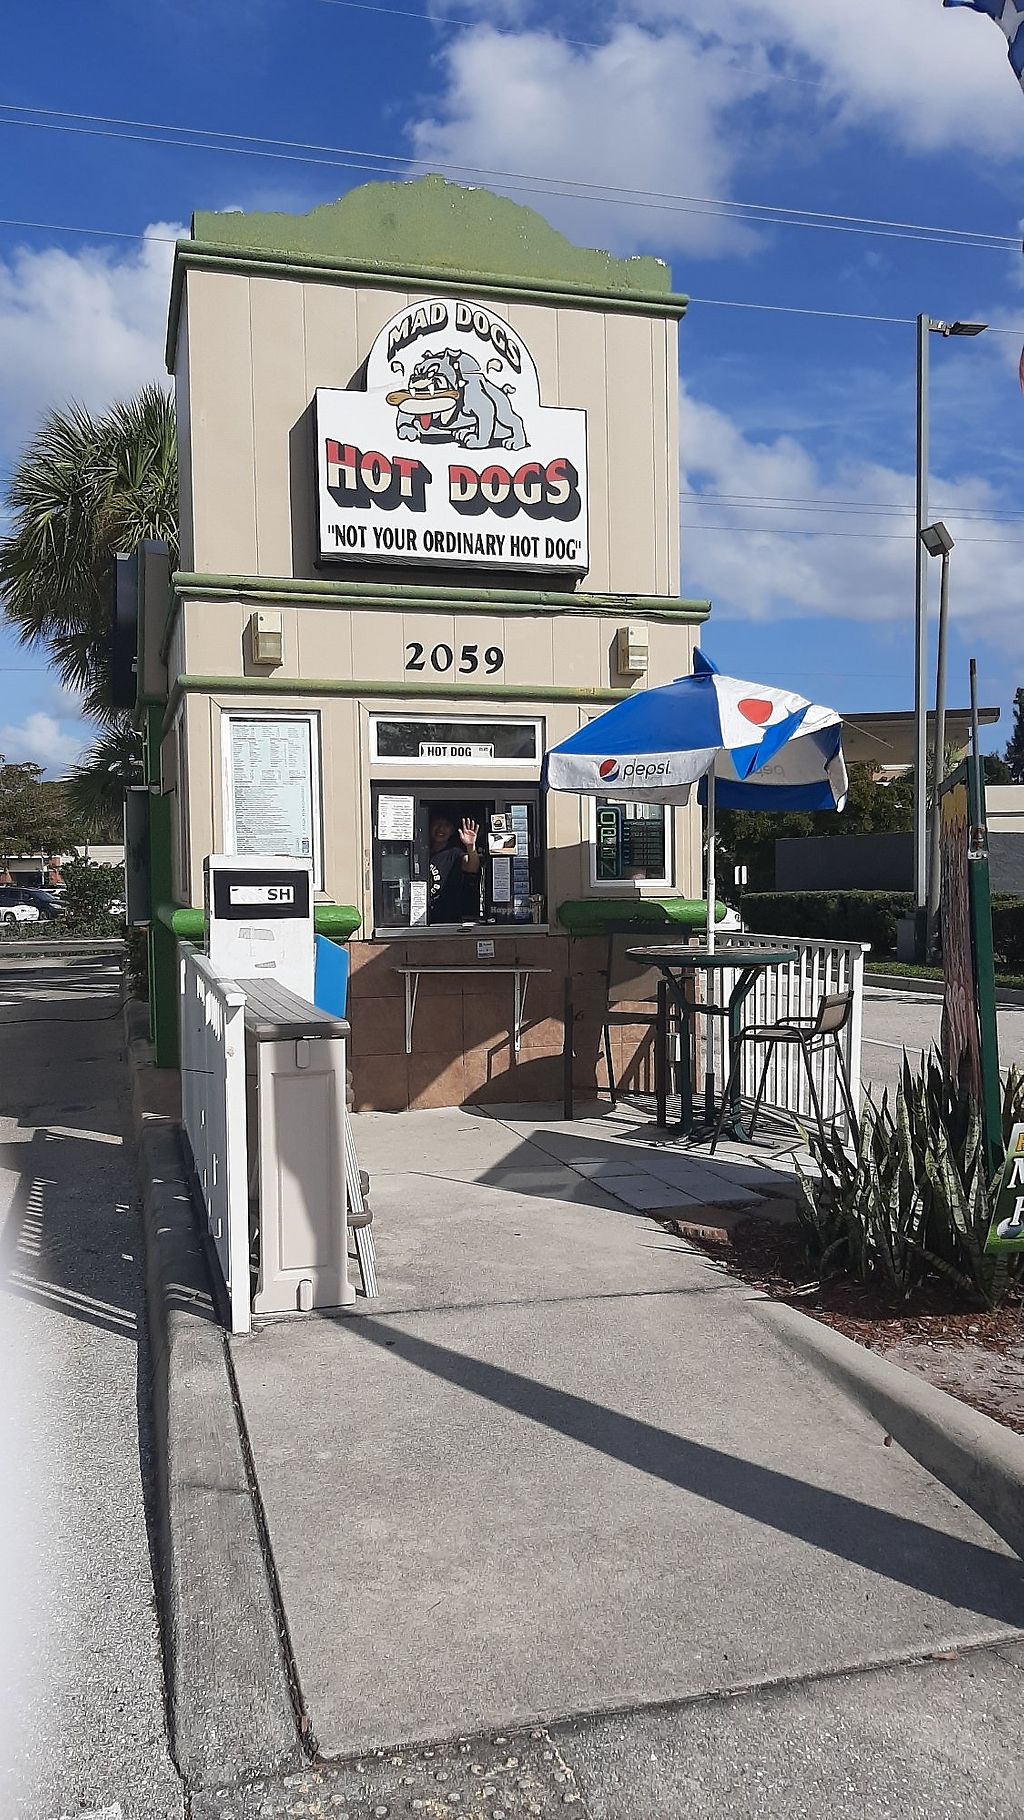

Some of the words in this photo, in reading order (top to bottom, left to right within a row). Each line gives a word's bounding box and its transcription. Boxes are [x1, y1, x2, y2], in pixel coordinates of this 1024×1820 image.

[387, 302, 448, 362] MAD
[455, 302, 522, 373] DOGS
[326, 438, 432, 512] HOT
[449, 458, 581, 522] DOGS
[327, 524, 368, 549] "NOT
[372, 527, 417, 551] YOUR
[423, 529, 506, 556] ORDINARY
[510, 535, 540, 558] HOT
[545, 537, 581, 560] DOG"
[405, 642, 505, 674] 2059
[427, 746, 447, 757] HOT
[450, 746, 472, 757] DOG
[623, 760, 670, 780] pepsi
